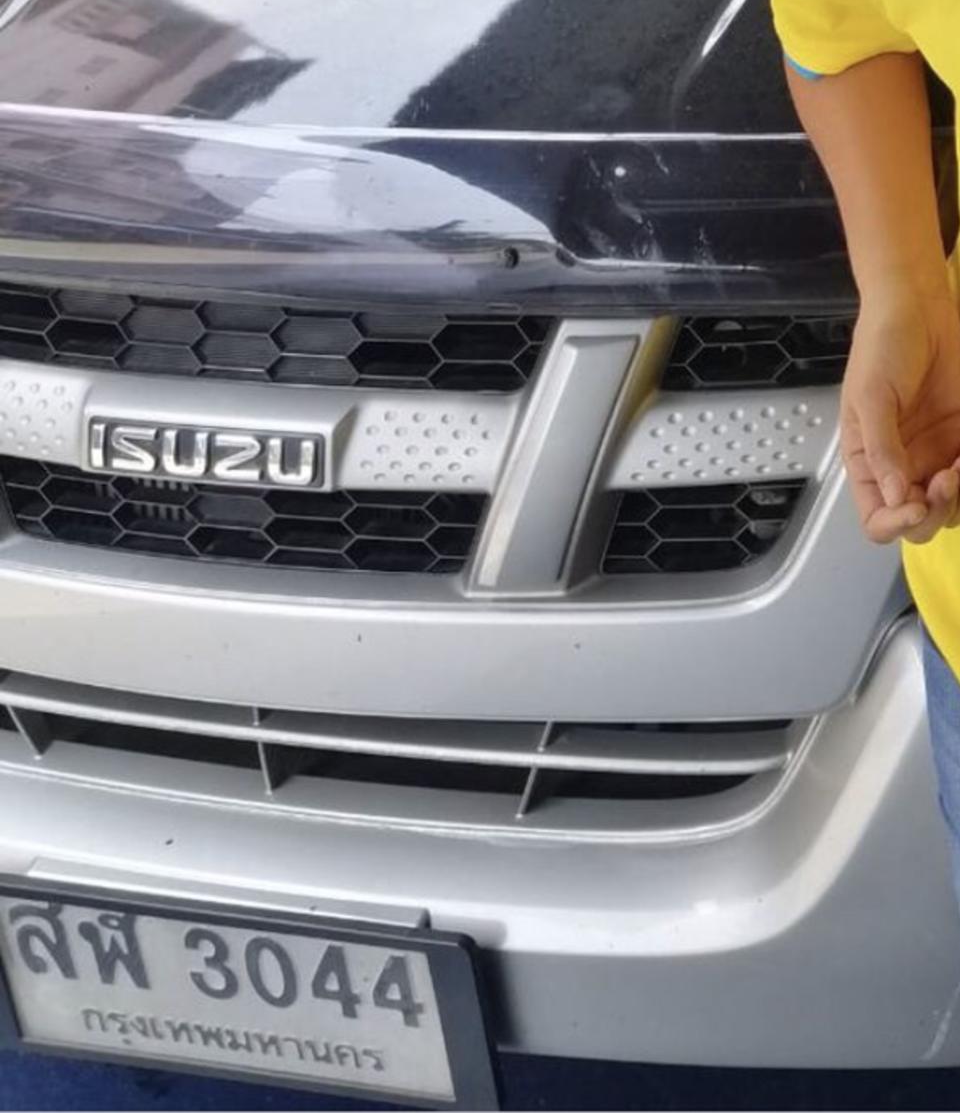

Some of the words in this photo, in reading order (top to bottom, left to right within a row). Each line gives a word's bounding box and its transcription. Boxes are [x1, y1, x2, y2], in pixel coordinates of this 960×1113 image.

[89, 423, 315, 486] ISUZU
[184, 927, 425, 1028] 3044
[81, 1007, 386, 1072] กรุงเทพมหานคร
